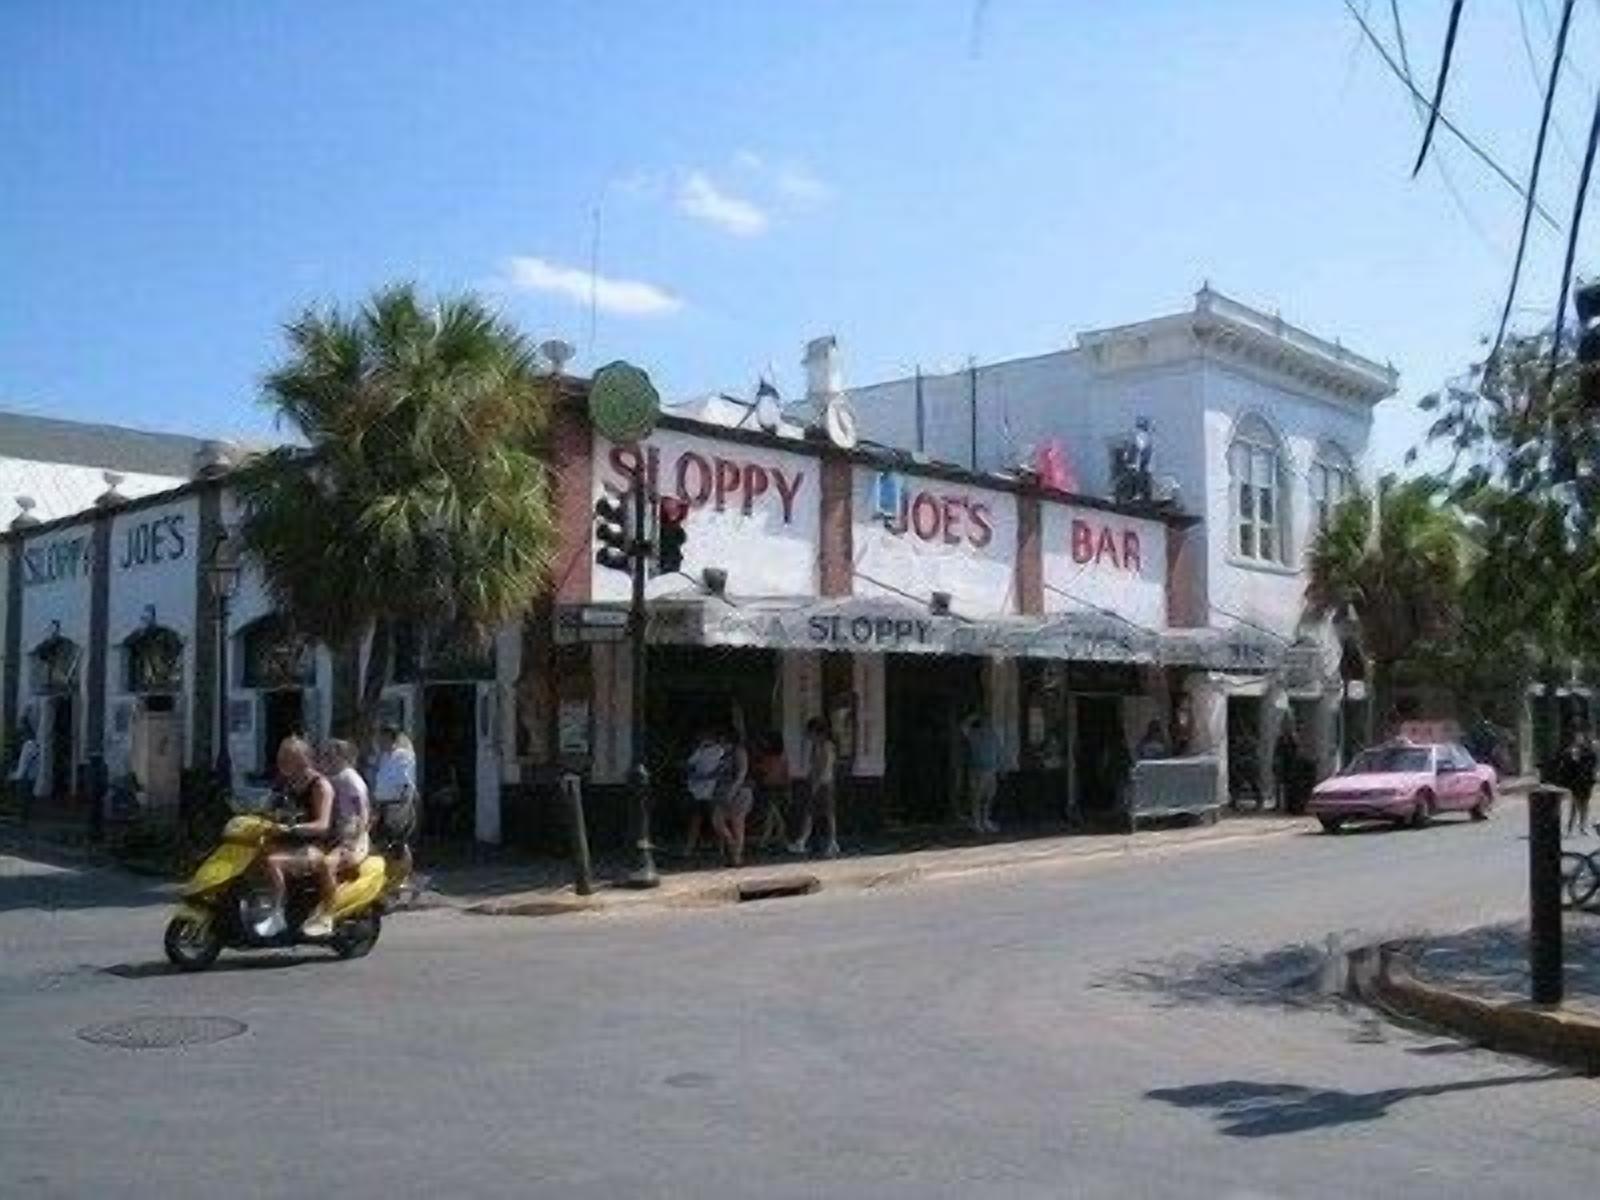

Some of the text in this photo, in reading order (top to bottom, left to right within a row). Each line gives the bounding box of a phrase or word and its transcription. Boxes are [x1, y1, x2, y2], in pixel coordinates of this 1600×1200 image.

[606, 446, 1142, 573] SLOPPY JOE'S BAR
[119, 514, 185, 569] JOE'S
[807, 614, 932, 645] SLOPPY
